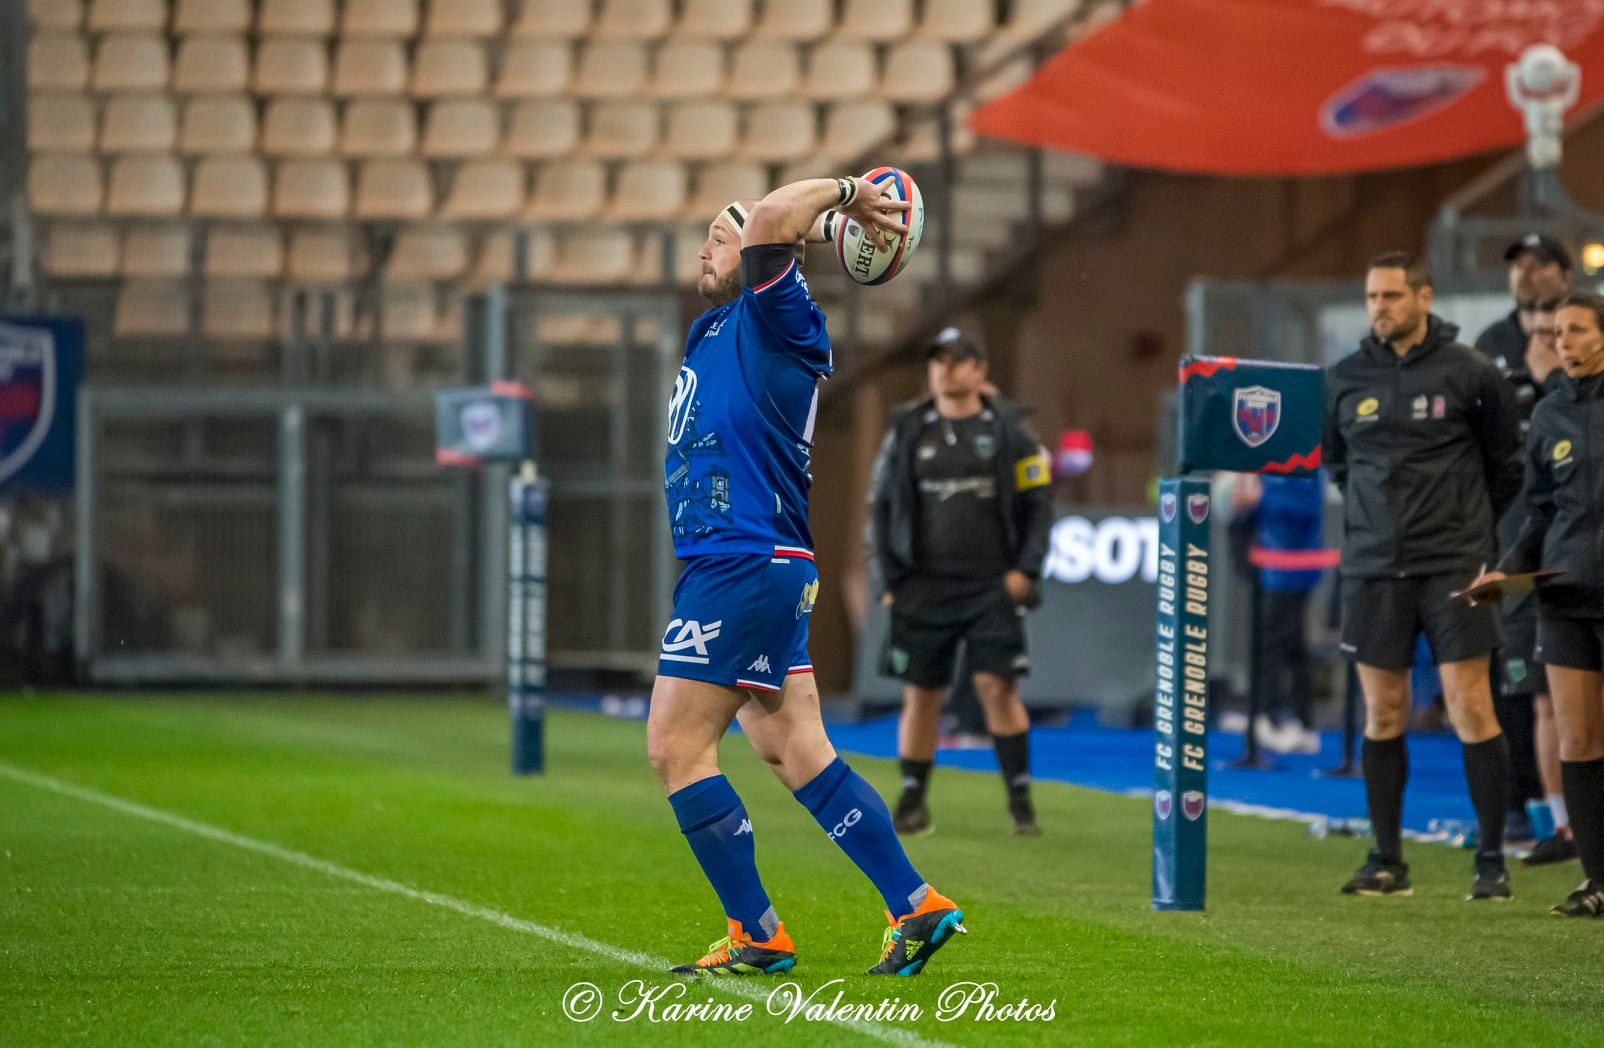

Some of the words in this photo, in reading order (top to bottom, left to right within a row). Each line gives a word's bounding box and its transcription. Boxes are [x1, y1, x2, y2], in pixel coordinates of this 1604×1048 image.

[855, 234, 876, 277] ERT
[1159, 543, 1176, 616] RUGBY
[1185, 543, 1209, 616] RUGBY
[1157, 623, 1175, 735] GRENOBLE
[1183, 624, 1207, 735] GRENOBLE
[1156, 742, 1173, 771] FC
[1182, 743, 1205, 772] FC
